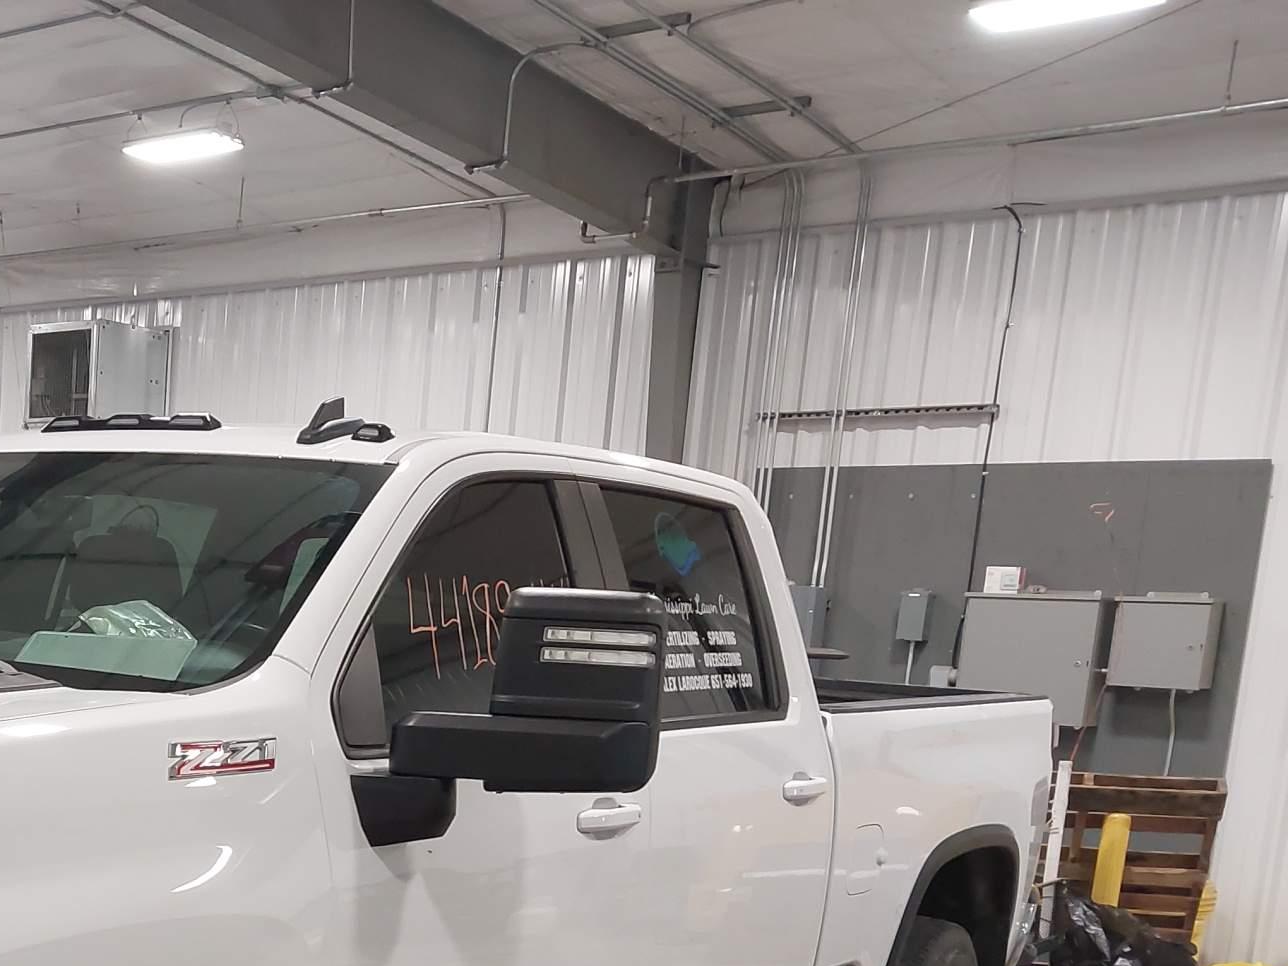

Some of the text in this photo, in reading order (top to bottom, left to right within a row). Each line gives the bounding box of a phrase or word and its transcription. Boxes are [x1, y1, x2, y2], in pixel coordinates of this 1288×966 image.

[694, 592, 718, 615] Lawn
[718, 593, 737, 616] Care
[666, 630, 700, 646] ERTILIZING
[706, 630, 737, 646] SPRAYING
[664, 653, 696, 669] AERATION
[703, 652, 743, 668] OVERSEEDING
[678, 674, 711, 691] LAROCQUE
[710, 672, 753, 690] 651-564-1930
[168, 737, 276, 781] Z71
